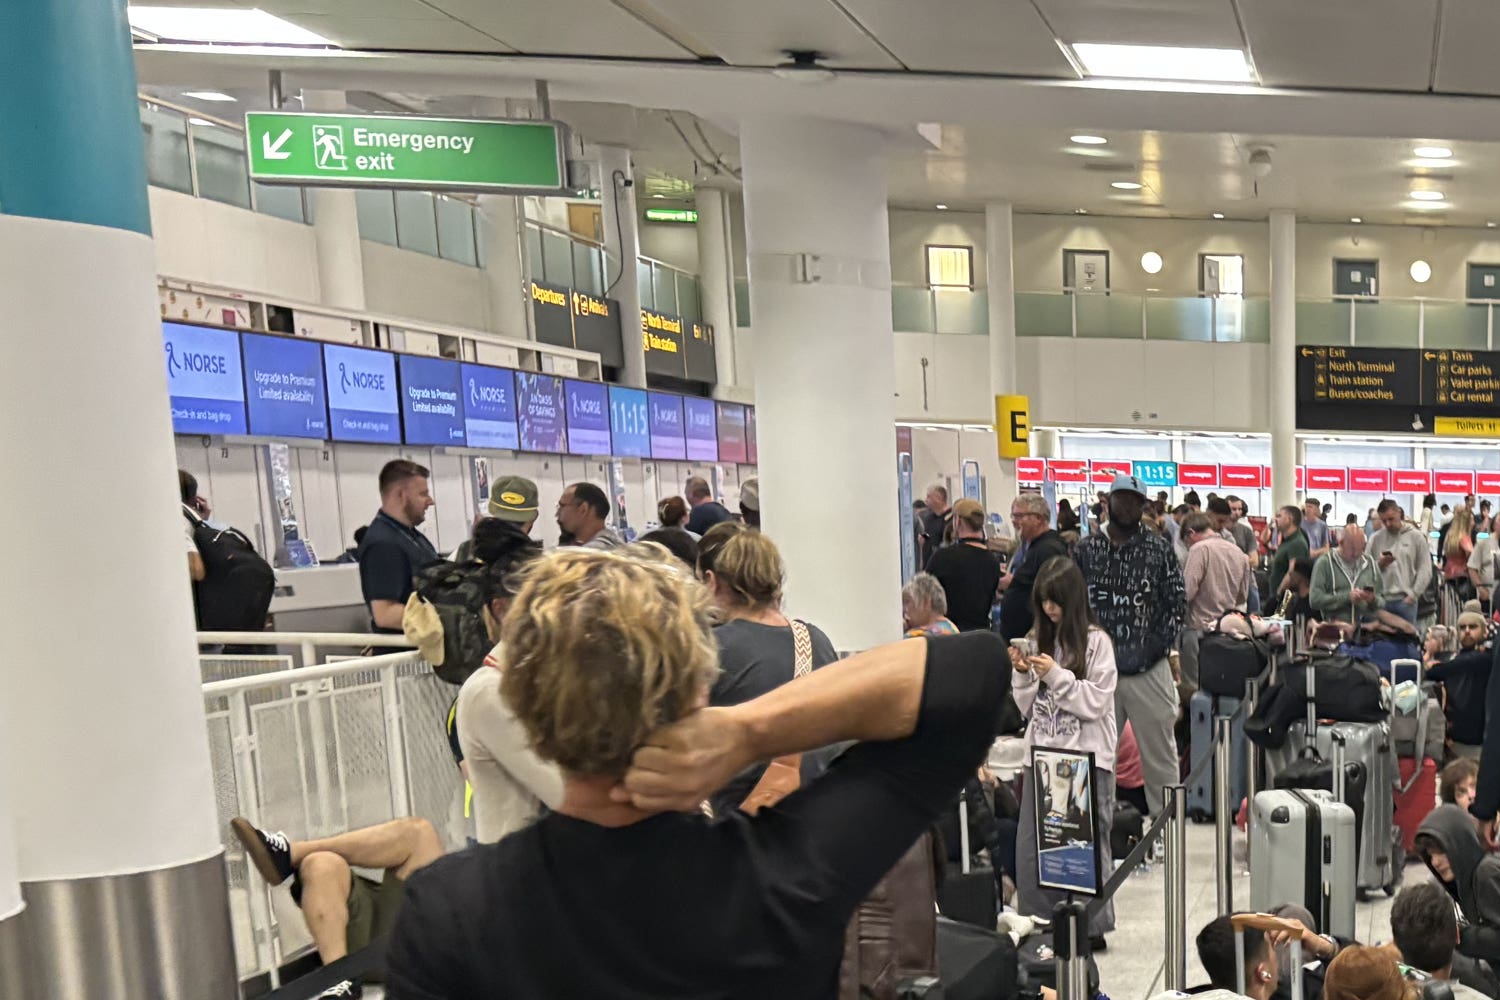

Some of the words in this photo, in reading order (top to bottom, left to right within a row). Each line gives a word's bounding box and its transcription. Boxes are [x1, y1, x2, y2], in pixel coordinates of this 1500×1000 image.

[353, 128, 475, 154] Emergency
[355, 152, 395, 171] exit
[531, 282, 566, 306] Departures
[1329, 348, 1346, 358] Exit
[1452, 351, 1474, 362] Taxis
[183, 352, 227, 375] NORSE
[1329, 361, 1355, 373] North
[1356, 361, 1395, 373] Terminal
[1450, 364, 1466, 375] Car
[1467, 366, 1492, 378] parks
[254, 369, 281, 386] Upgrade
[281, 374, 289, 384] to
[289, 374, 316, 387] Premium
[353, 371, 386, 391] NORSE
[1329, 374, 1351, 386] Train
[1353, 376, 1384, 387] station
[1450, 378, 1474, 389] Valet
[259, 387, 282, 401] Limited
[282, 389, 314, 405] availability
[408, 385, 431, 401] Upgrade
[431, 388, 437, 399] to
[437, 388, 457, 400] Premium
[479, 385, 506, 404] NORSE
[1329, 388, 1394, 400] Buses/coaches
[1450, 391, 1466, 402] Car
[1467, 391, 1494, 403] rental
[412, 401, 432, 414] Limited
[432, 402, 456, 417] availability
[611, 400, 648, 435] 11:15
[1010, 410, 1028, 443] E
[1135, 463, 1175, 481] 11:15
